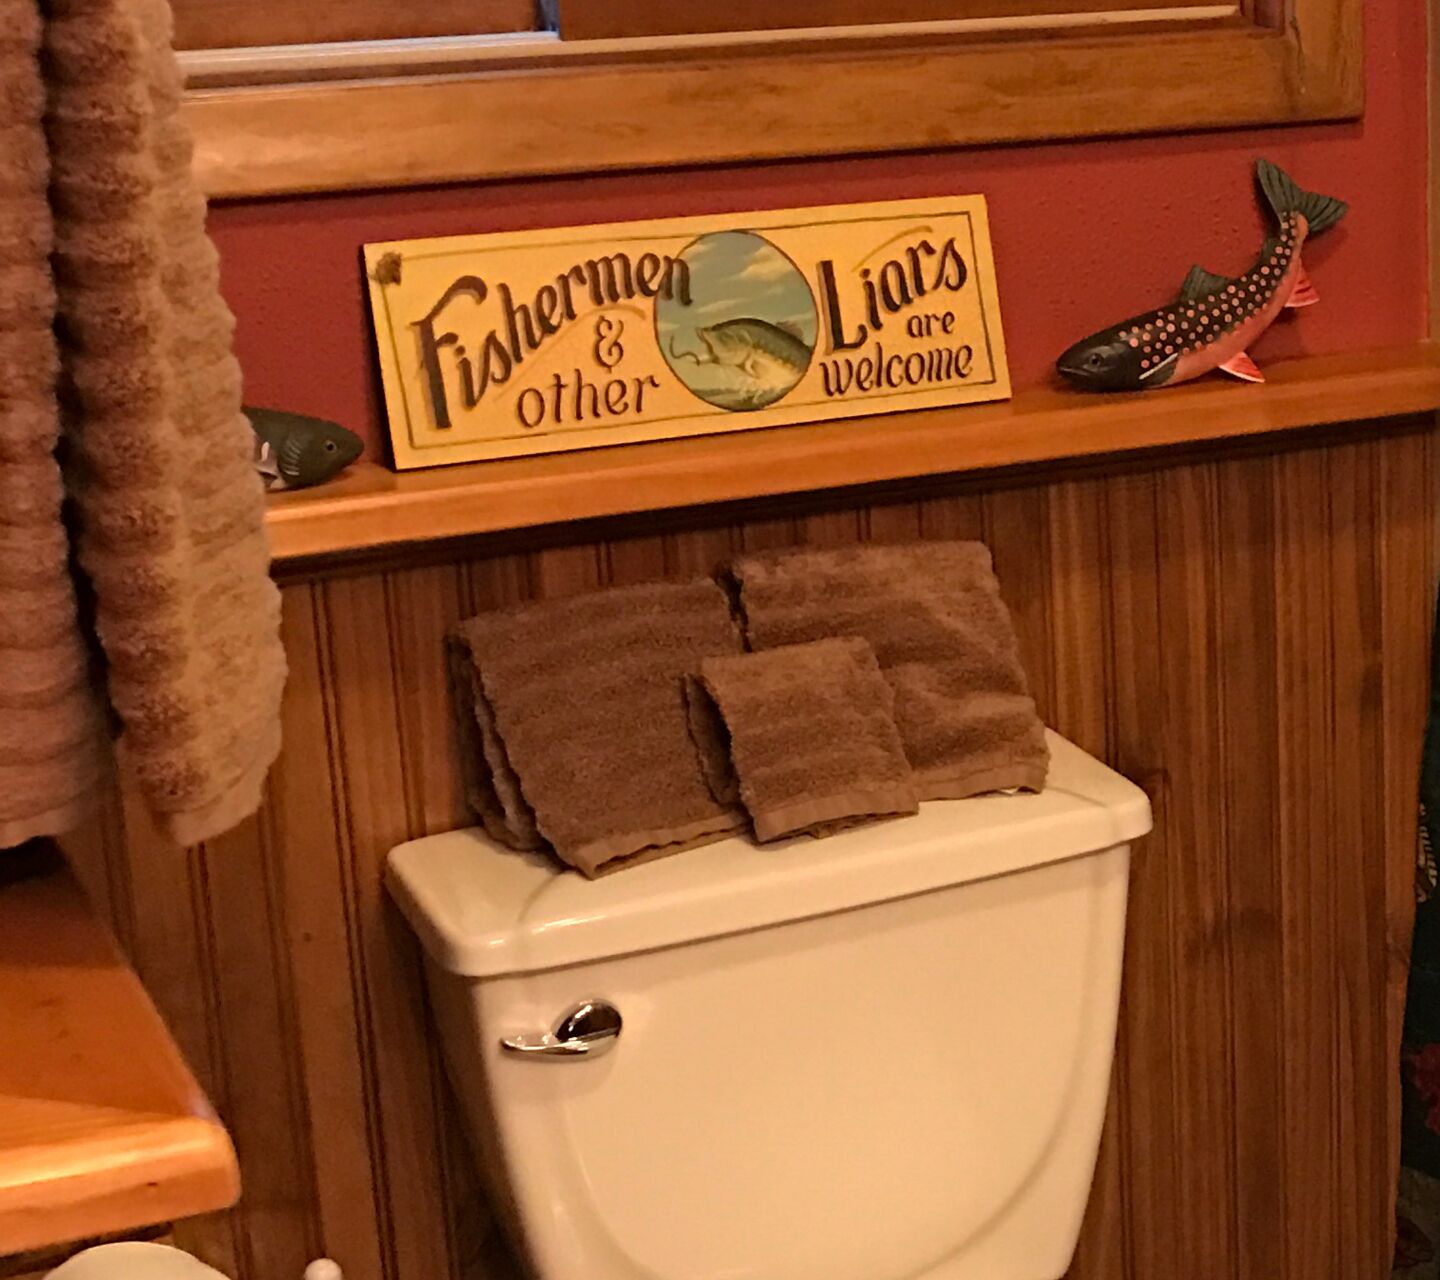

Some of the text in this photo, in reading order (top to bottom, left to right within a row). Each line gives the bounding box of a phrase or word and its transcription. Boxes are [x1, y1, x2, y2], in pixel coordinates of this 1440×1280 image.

[816, 237, 968, 355] Liars
[907, 311, 955, 338] are
[409, 252, 692, 429] Fishermen
[595, 314, 624, 372] &
[819, 342, 973, 397] welcome
[517, 367, 660, 428] other
